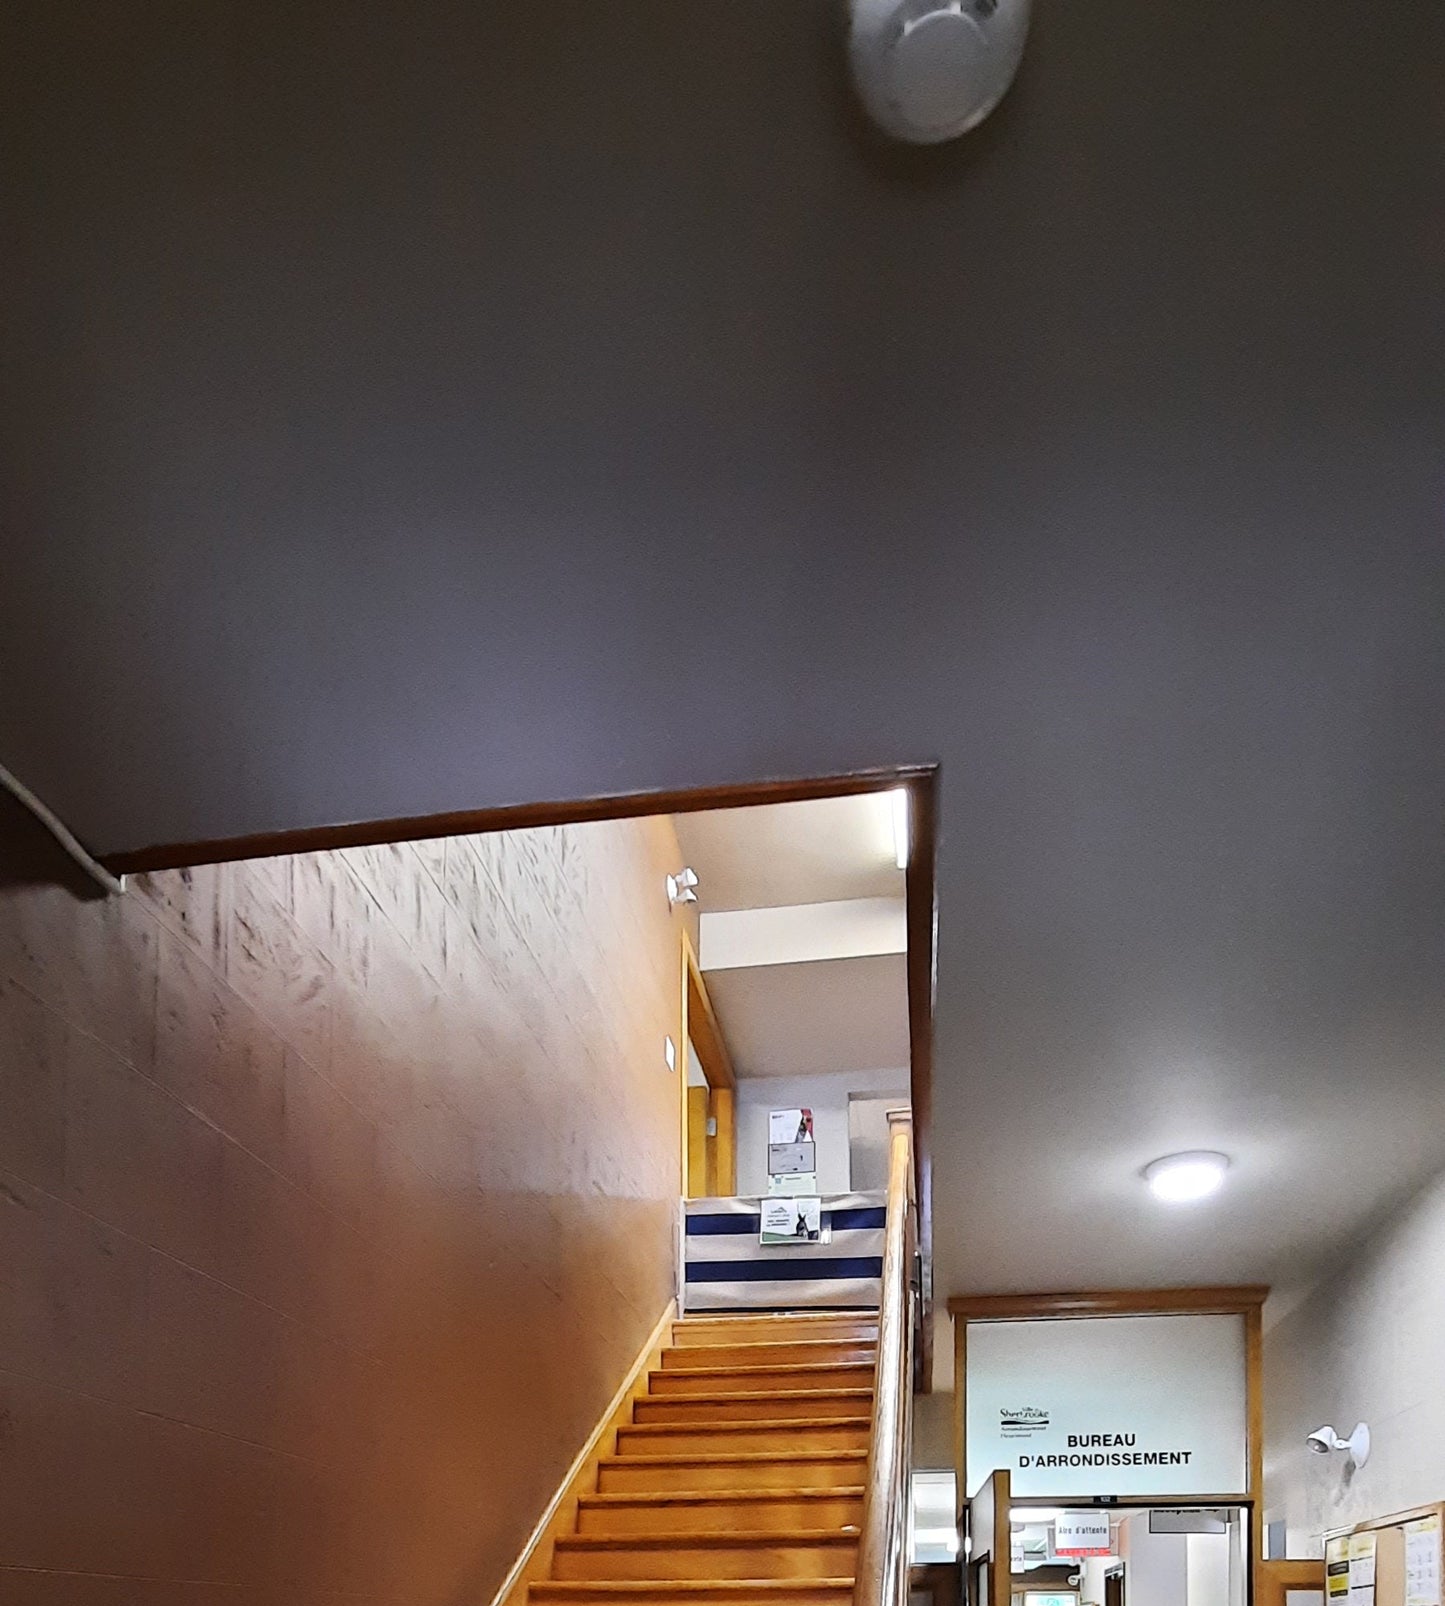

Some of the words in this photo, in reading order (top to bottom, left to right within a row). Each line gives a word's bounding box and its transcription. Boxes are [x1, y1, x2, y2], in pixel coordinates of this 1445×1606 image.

[1067, 1433, 1136, 1448] BUREAU
[1019, 1451, 1192, 1468] D'ARRONDISSEMENT
[1059, 1526, 1072, 1535] Aire
[1075, 1526, 1107, 1535] d'attente
